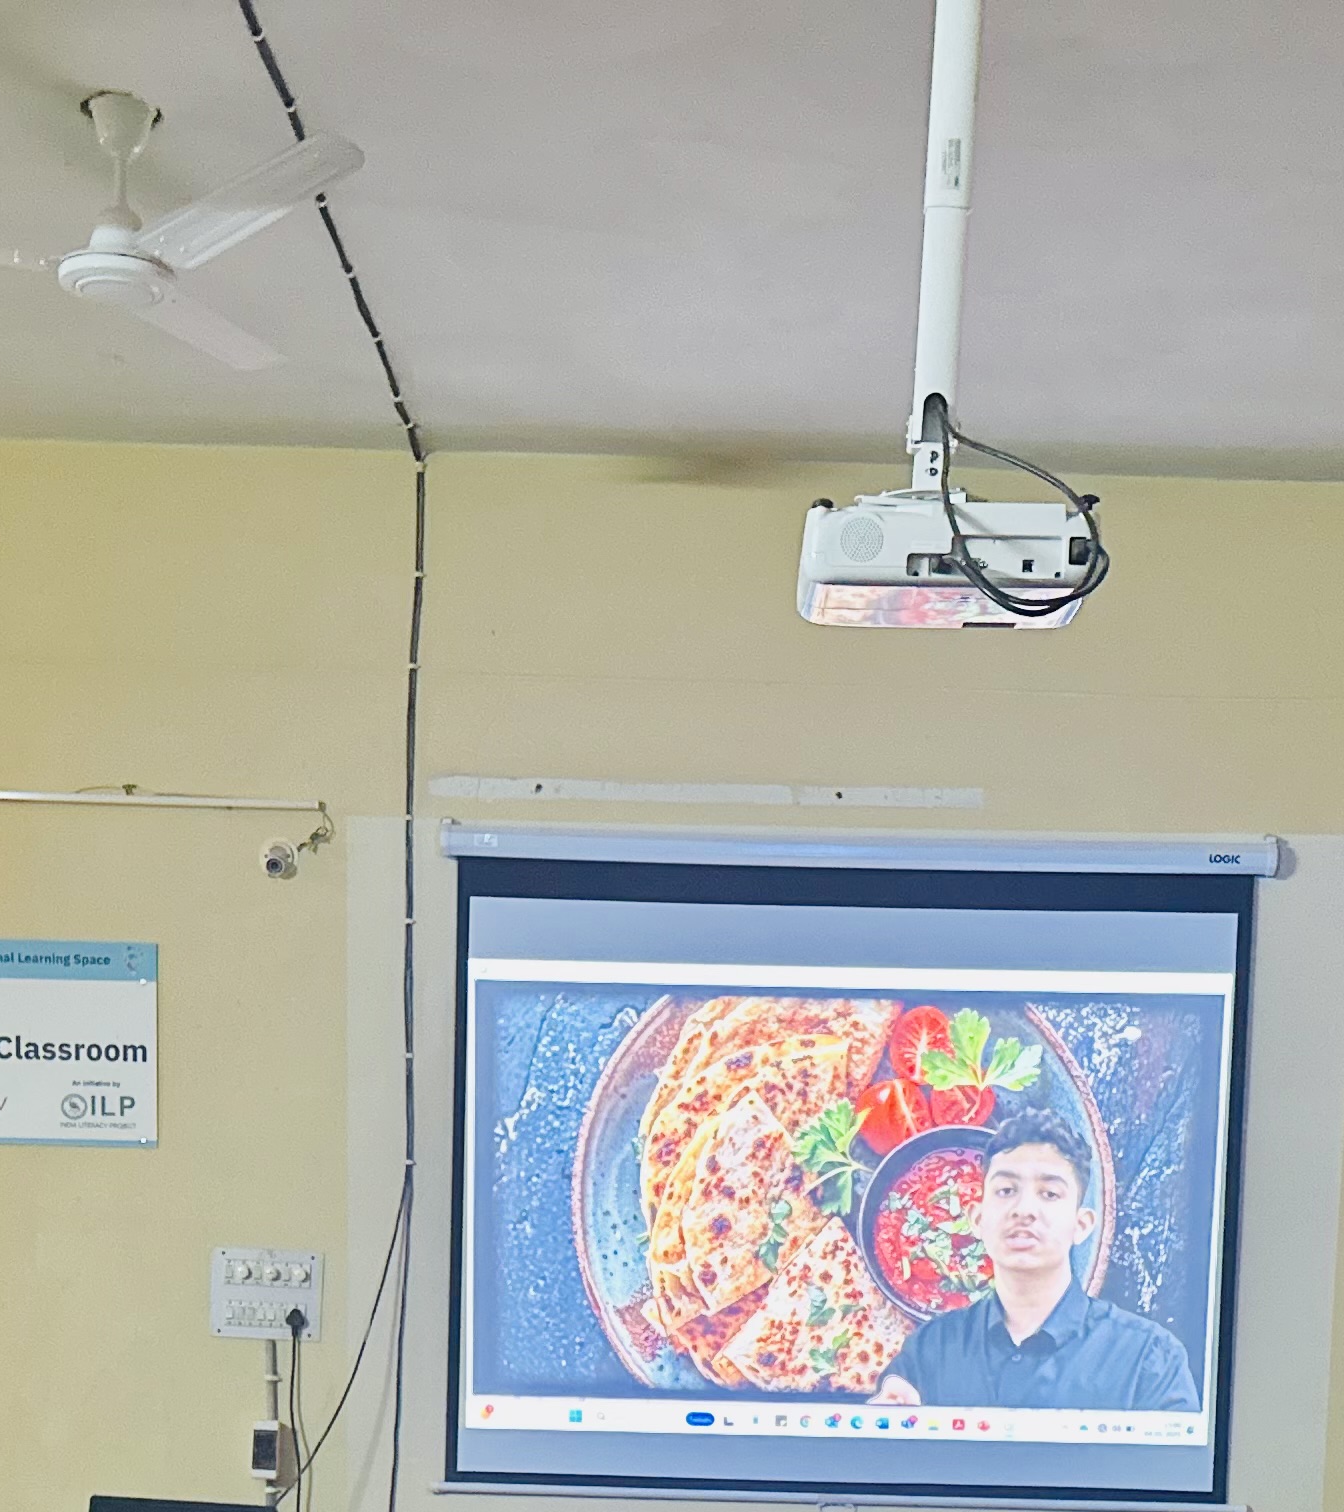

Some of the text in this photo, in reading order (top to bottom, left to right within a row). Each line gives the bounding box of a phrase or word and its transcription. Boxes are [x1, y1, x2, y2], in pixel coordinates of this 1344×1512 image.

[1208, 854, 1241, 864] LOGIC
[17, 952, 71, 967] Learning
[73, 953, 111, 967] Space
[90, 1095, 136, 1117] ILP
